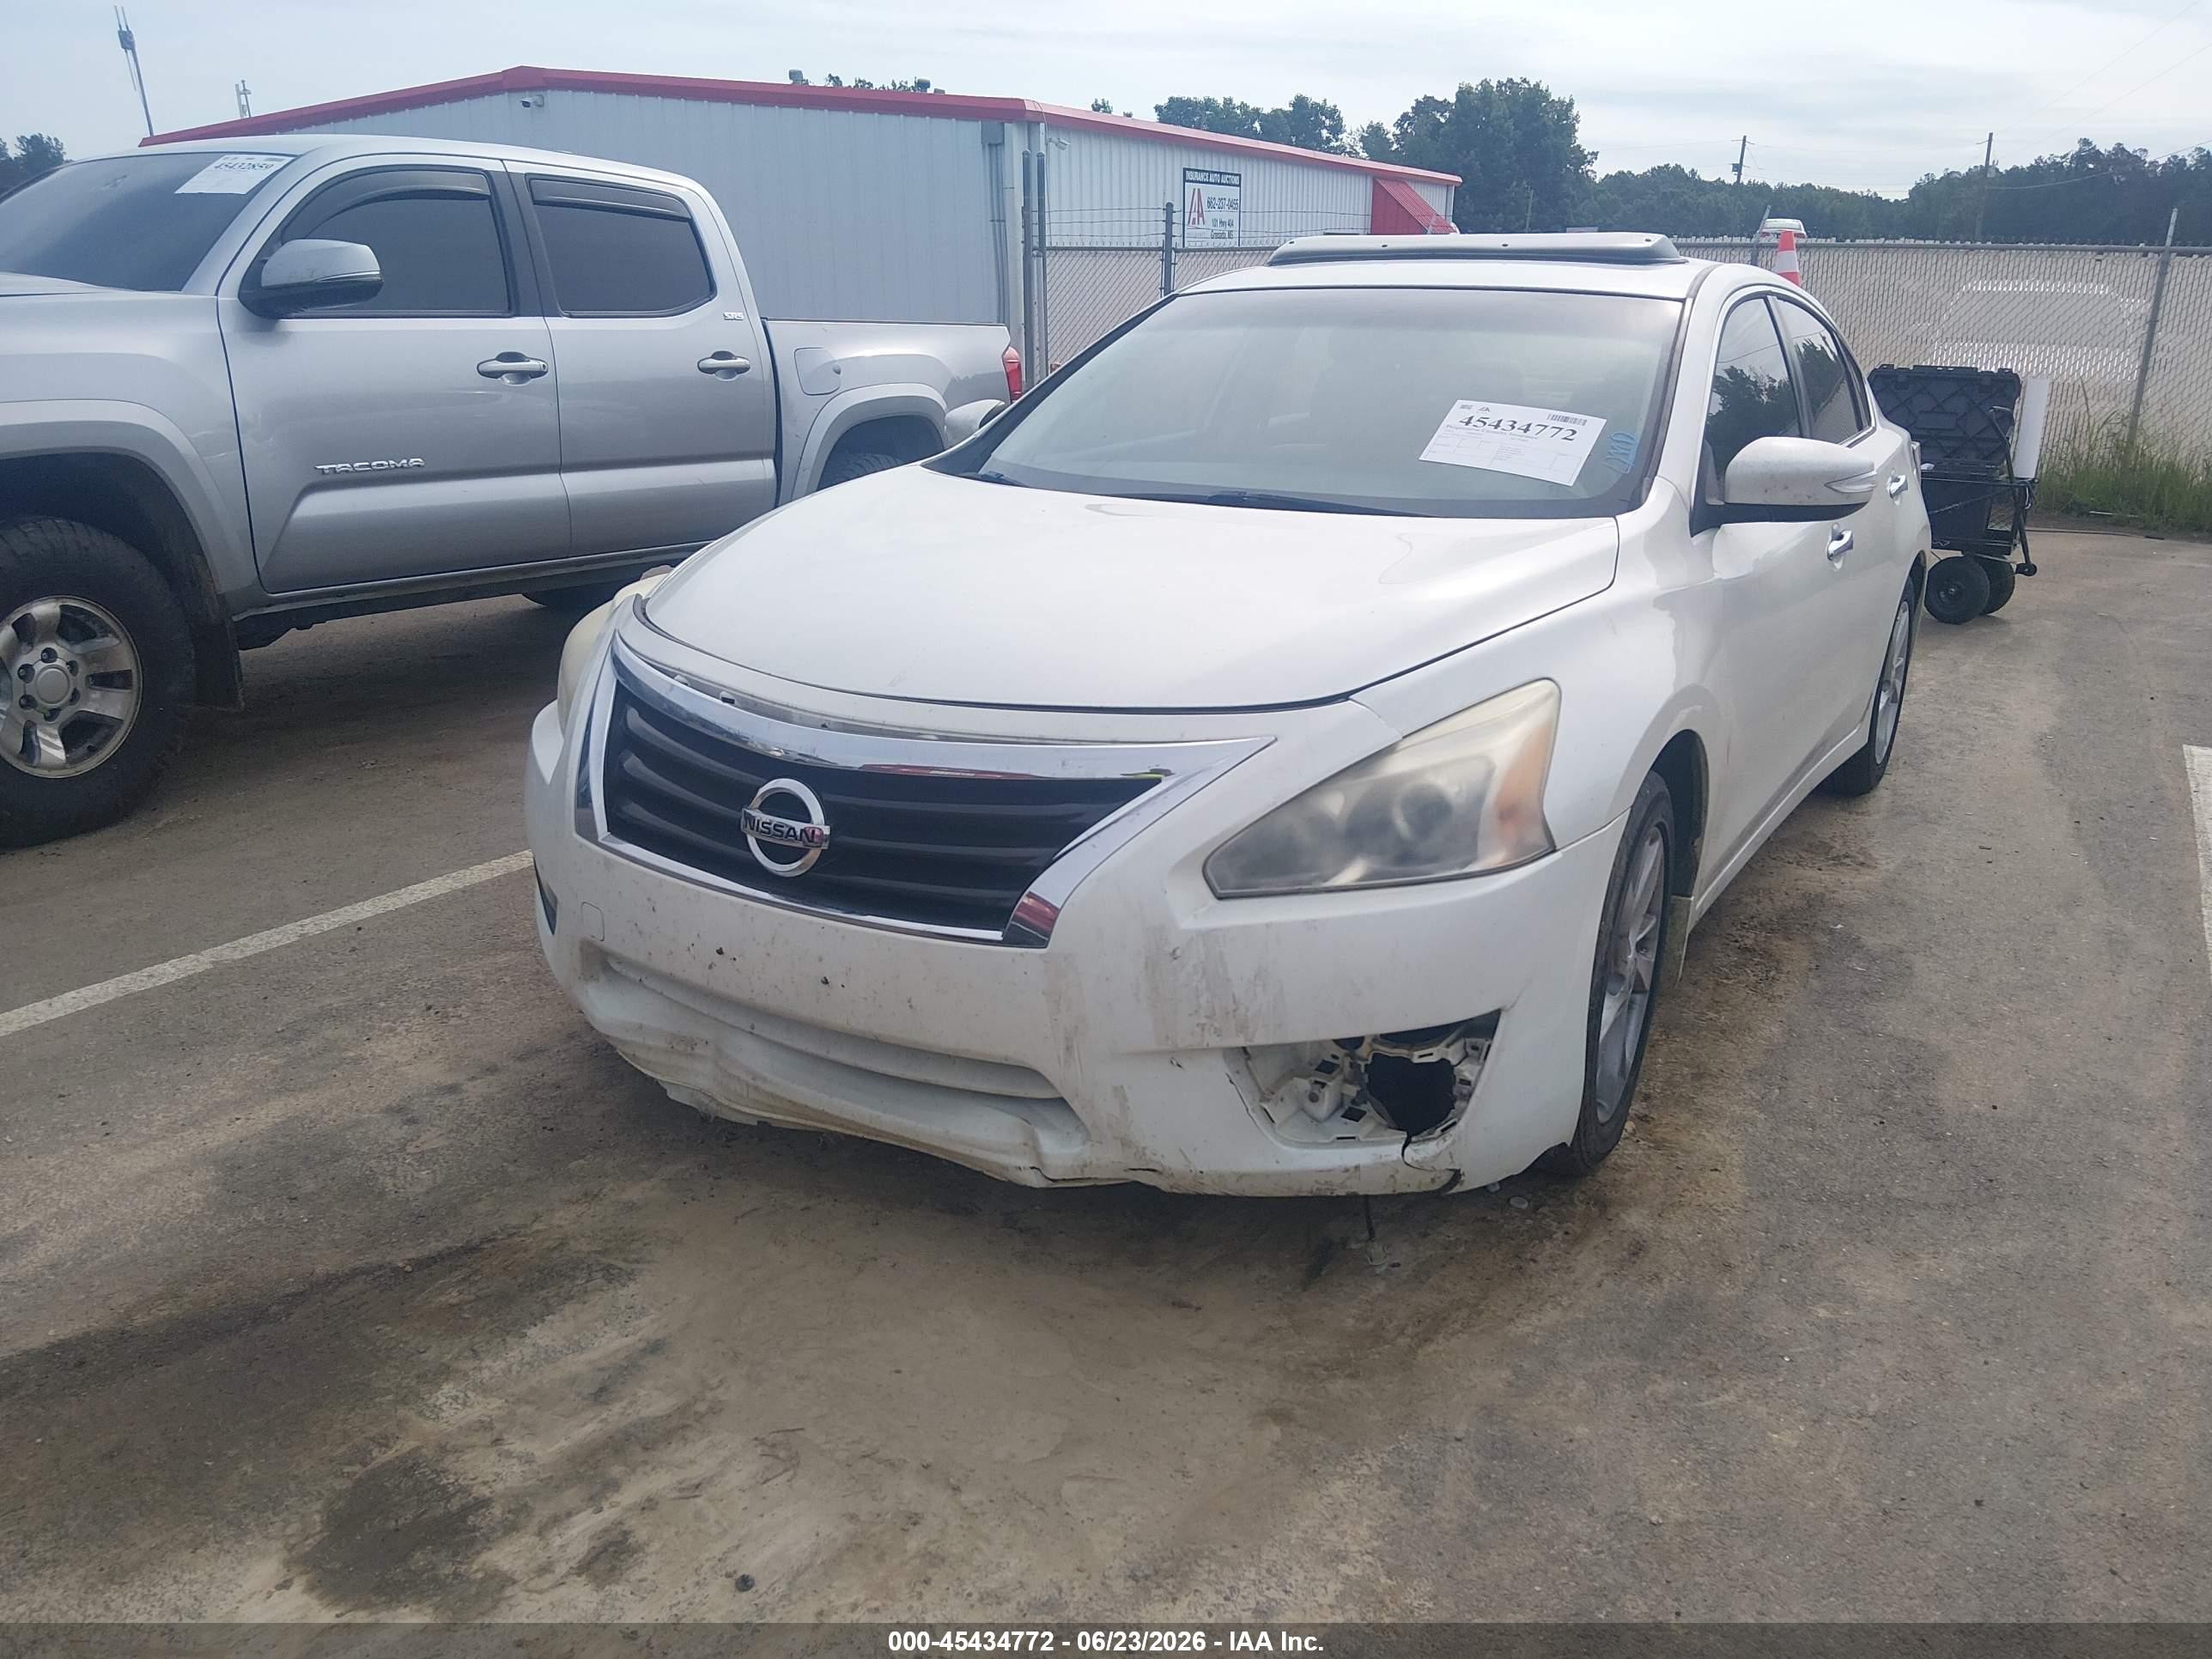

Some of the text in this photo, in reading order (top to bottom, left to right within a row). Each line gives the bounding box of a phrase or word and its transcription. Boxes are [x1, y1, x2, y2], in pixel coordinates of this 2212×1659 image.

[1186, 170, 1240, 185] INSURANCE AUTO AUCTIONS
[1458, 415, 1577, 441] 45434772
[314, 458, 426, 475] TACOMA
[743, 812, 816, 844] NISSAN
